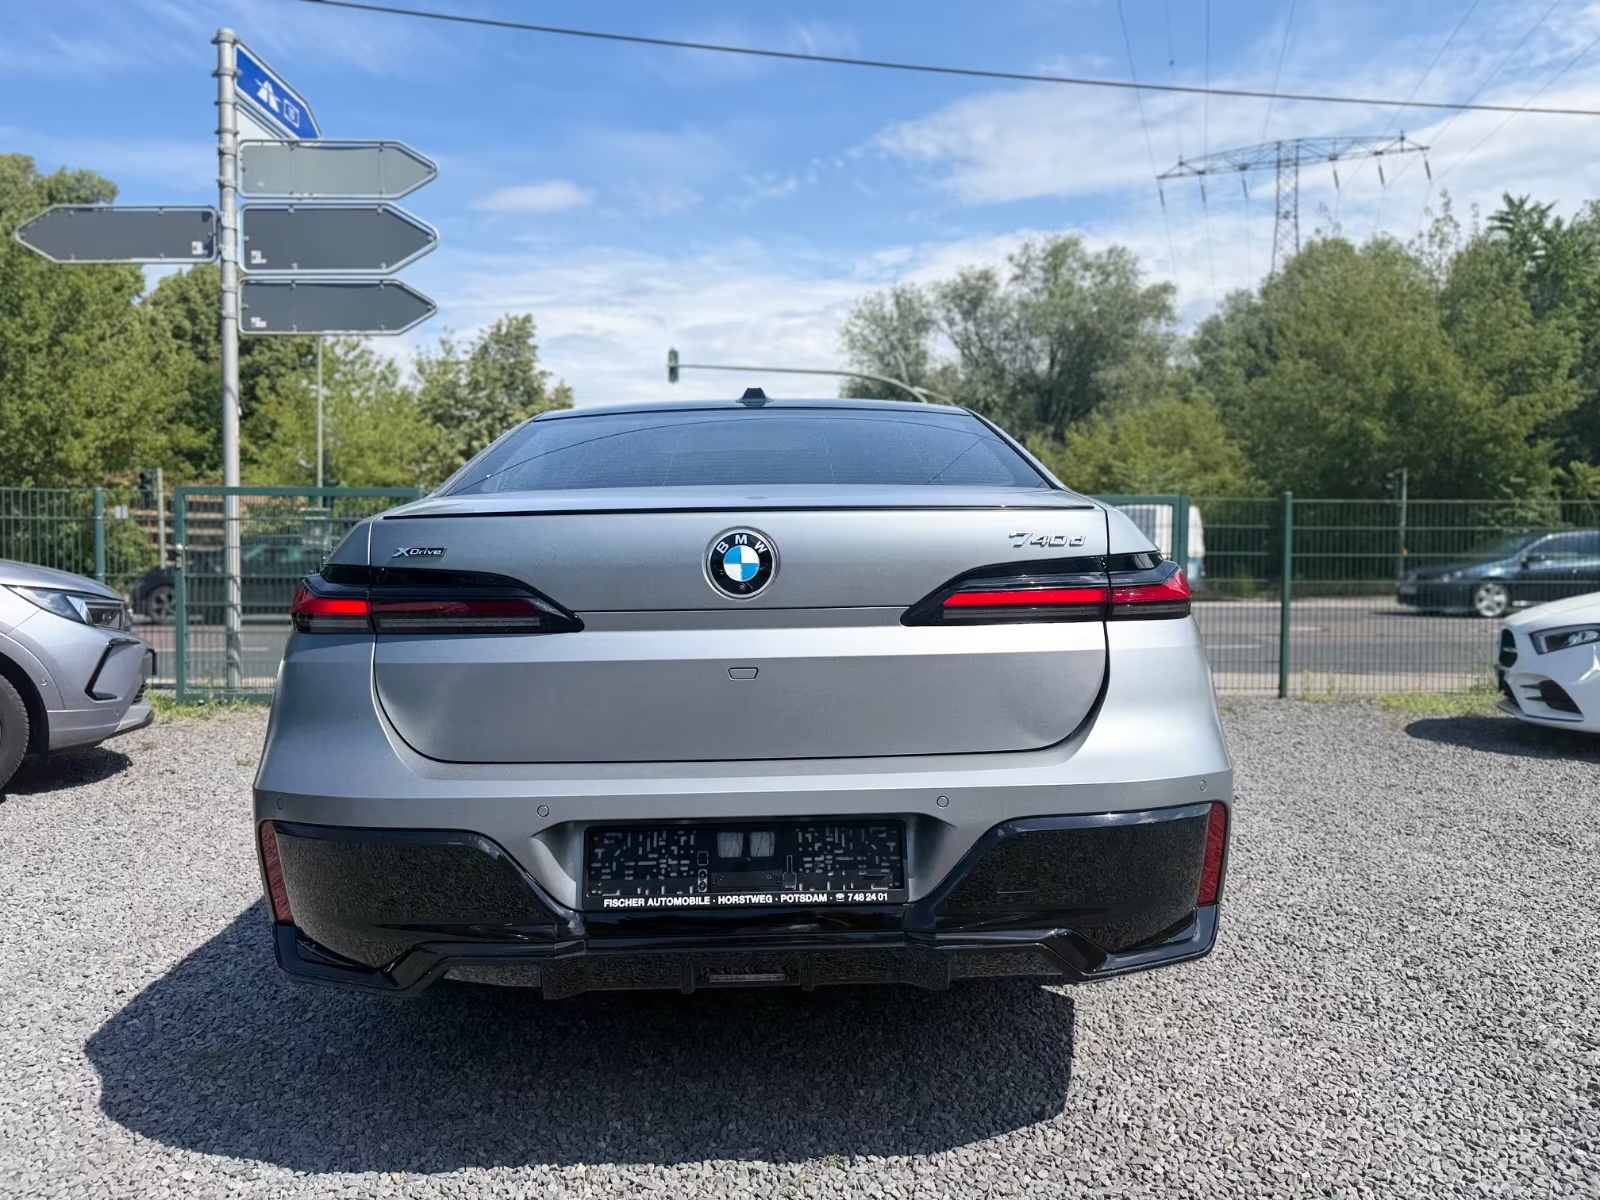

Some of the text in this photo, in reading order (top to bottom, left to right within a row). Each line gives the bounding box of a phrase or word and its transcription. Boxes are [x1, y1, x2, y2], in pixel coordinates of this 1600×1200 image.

[716, 534, 768, 554] BMW
[1008, 531, 1086, 548] 740d
[603, 897, 645, 908] FISCHER
[647, 896, 711, 906] AUTOMOBILE
[717, 894, 773, 905] HORSTWEG
[780, 893, 828, 903] POTSDAM
